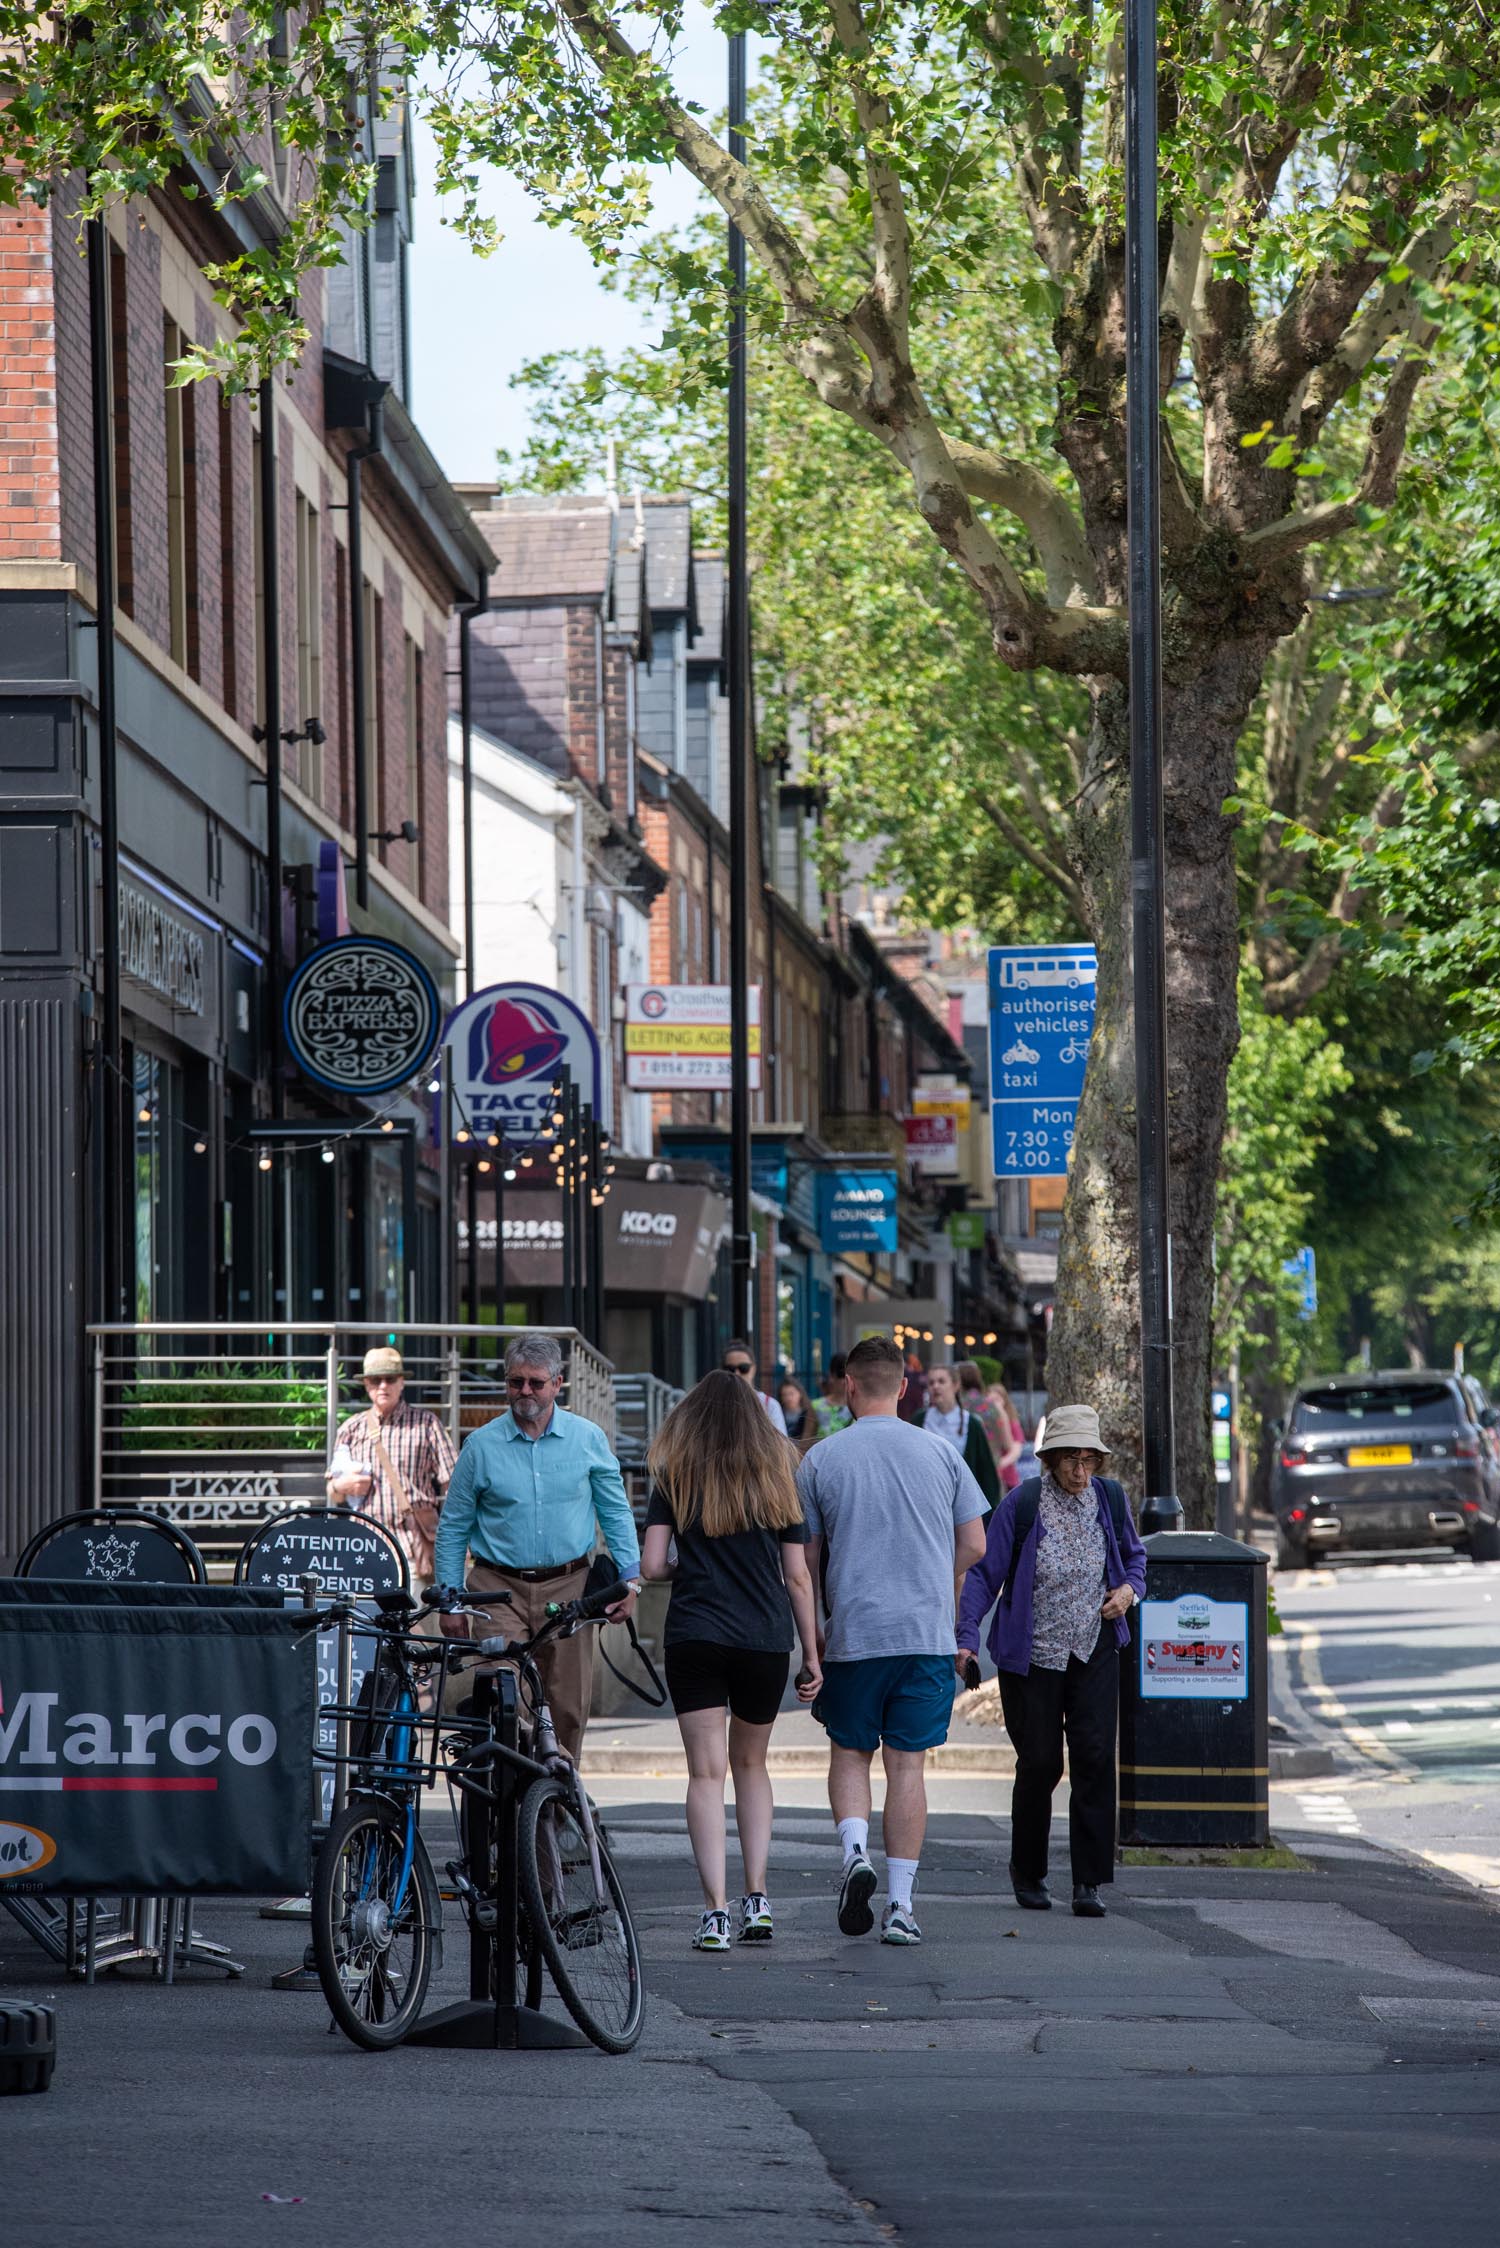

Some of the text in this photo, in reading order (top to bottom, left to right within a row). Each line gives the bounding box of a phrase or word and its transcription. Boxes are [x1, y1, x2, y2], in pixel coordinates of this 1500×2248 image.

[327, 995, 396, 1013] PIZZA
[307, 1013, 415, 1030] EXPRESS
[1015, 1016, 1089, 1034] vehicles
[631, 1029, 694, 1046] LETTING
[1003, 1071, 1038, 1087] taxi
[1033, 1108, 1073, 1124] Mon
[1006, 1131, 1048, 1147] 7.30
[1005, 1151, 1050, 1167] 4.00
[620, 1210, 677, 1235] KOKO
[831, 1208, 887, 1222] LOUNGE
[168, 1470, 281, 1497] PIZZA
[274, 1534, 377, 1553] ATTENTION
[308, 1556, 344, 1571] ALL
[276, 1574, 375, 1592] STDENTS
[1161, 1641, 1227, 1661] Sweeny
[1151, 1676, 1185, 1684] Supporting
[0, 1692, 278, 1766] Marco
